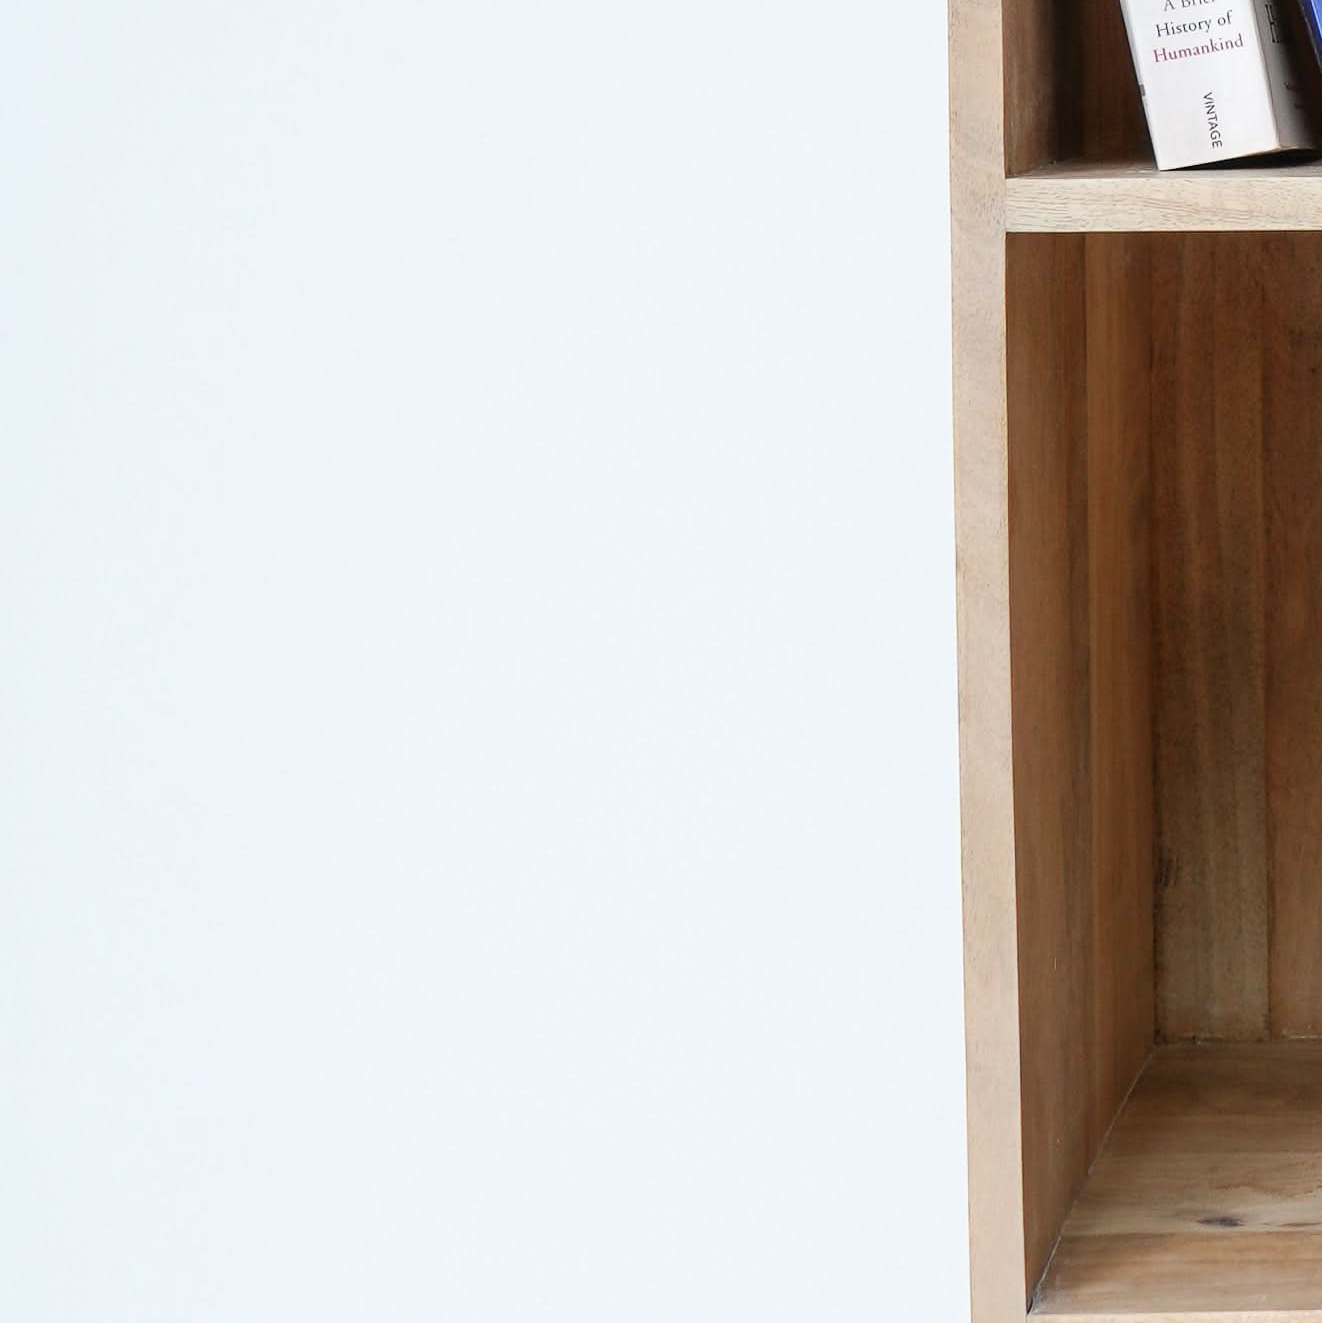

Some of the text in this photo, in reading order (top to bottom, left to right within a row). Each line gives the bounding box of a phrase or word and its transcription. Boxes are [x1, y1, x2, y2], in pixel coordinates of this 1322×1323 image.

[1156, 10, 1233, 37] History of
[1153, 34, 1244, 63] Humankind
[1203, 92, 1223, 149] VINTAGE
